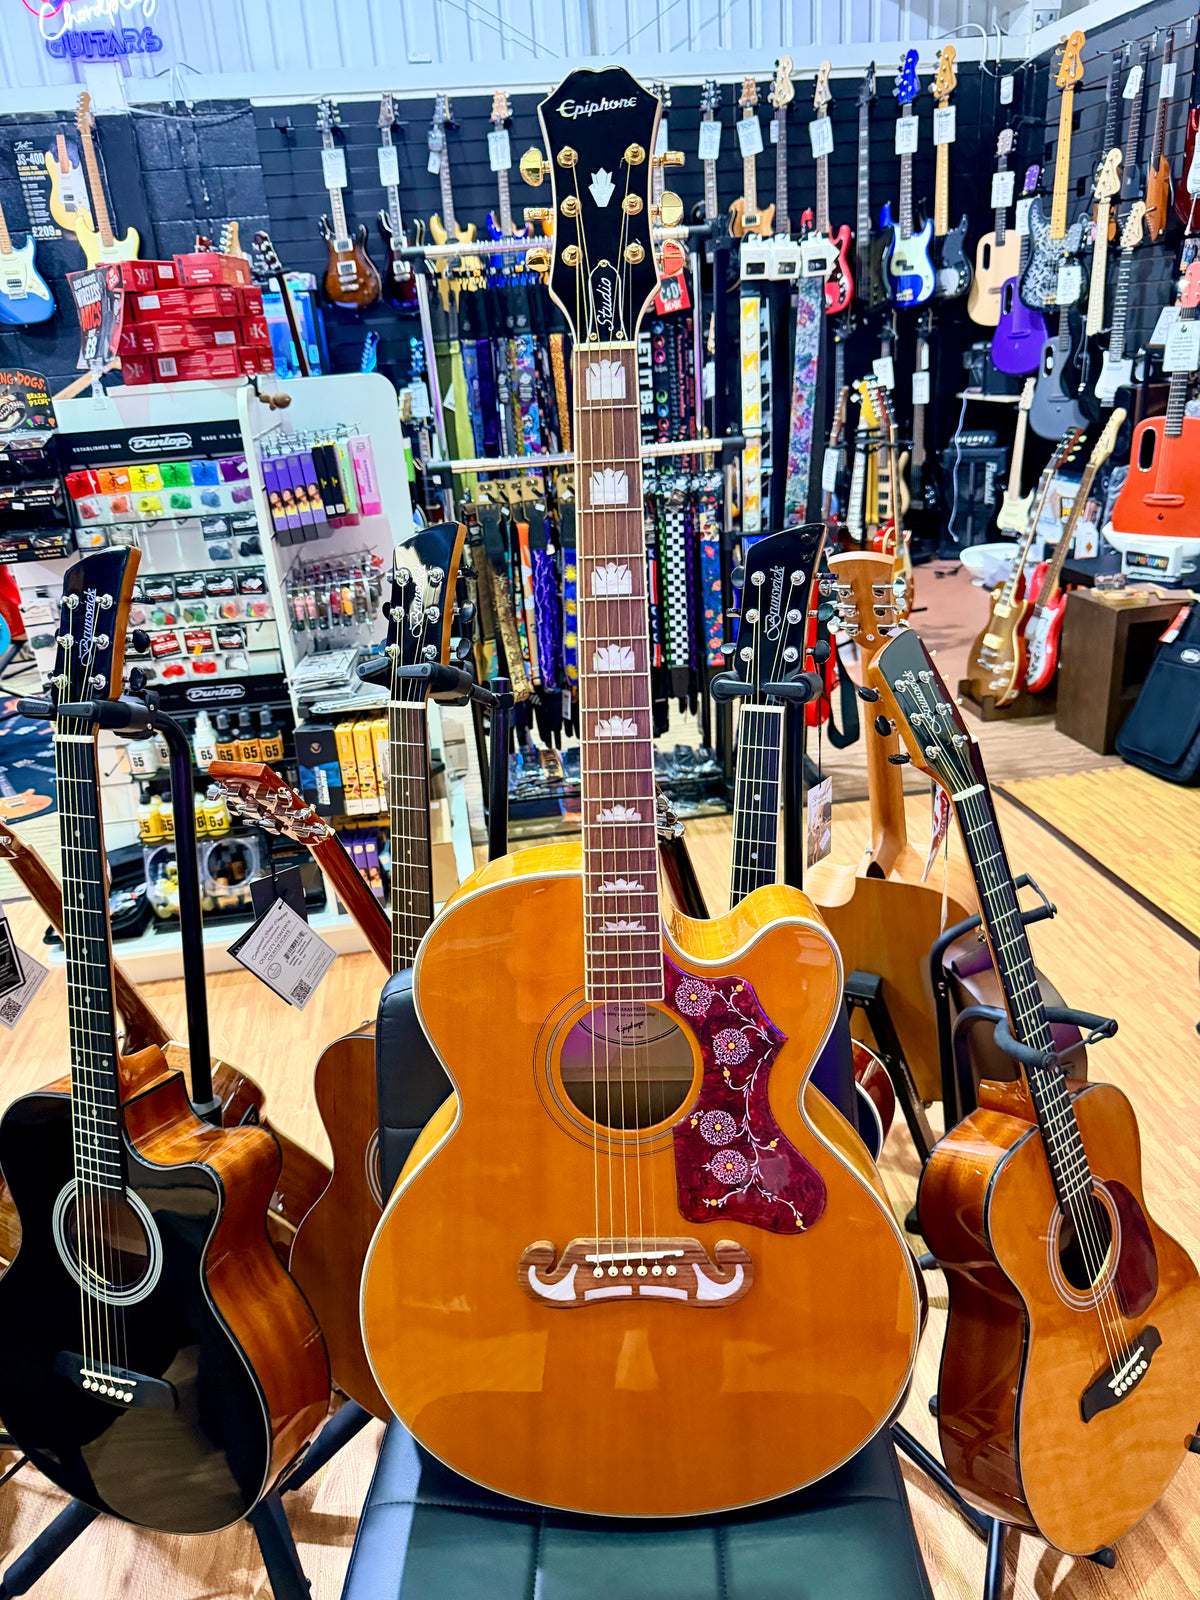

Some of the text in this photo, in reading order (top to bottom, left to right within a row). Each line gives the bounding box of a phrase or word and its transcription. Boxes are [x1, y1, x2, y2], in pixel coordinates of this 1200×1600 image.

[46, 26, 163, 59] GUITARS
[555, 97, 637, 119] Epiphone
[15, 152, 45, 166] JS-400
[596, 277, 615, 331] Studio
[80, 301, 102, 331] MICS
[638, 332, 653, 367] LET
[639, 368, 653, 389] IT
[640, 390, 655, 415] BE
[132, 437, 190, 450] Dunlop
[984, 461, 997, 505] Randall
[763, 565, 785, 642] Brunswick
[78, 588, 97, 667] Brunswick
[188, 687, 245, 700] Dunlop
[133, 756, 144, 767] 65
[201, 749, 213, 760] 65
[219, 749, 233, 761] 65
[243, 746, 258, 759] 65
[265, 744, 279, 758] 65
